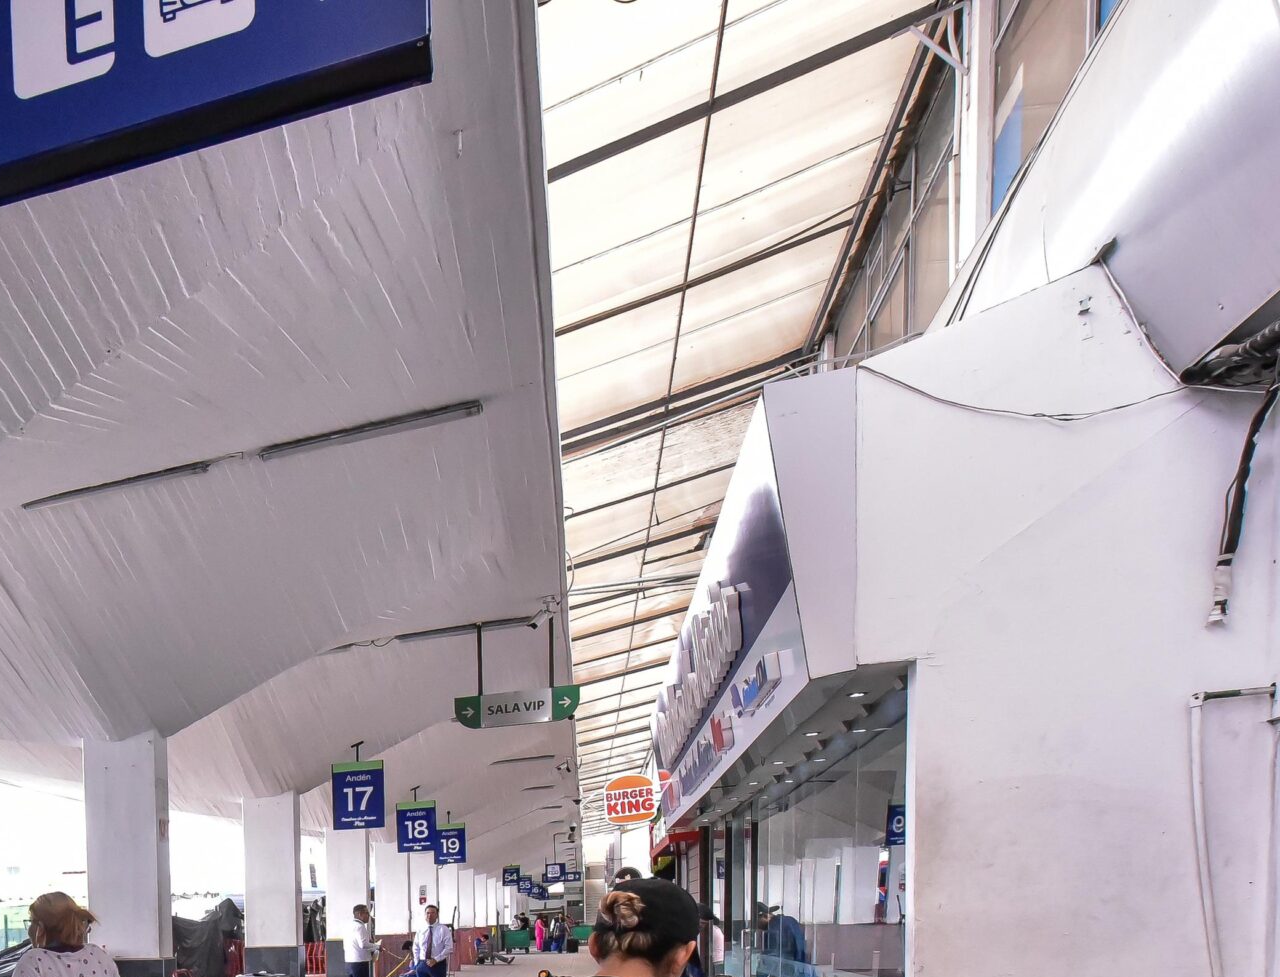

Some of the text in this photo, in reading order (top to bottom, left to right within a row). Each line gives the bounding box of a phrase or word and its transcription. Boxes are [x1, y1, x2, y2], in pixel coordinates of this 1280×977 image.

[487, 700, 545, 716] SALA VIP
[346, 773, 371, 782] Andén
[343, 786, 374, 812] 17
[605, 787, 653, 802] BURGER
[606, 797, 655, 816] KING
[404, 820, 429, 839] 18
[440, 838, 460, 853] 19
